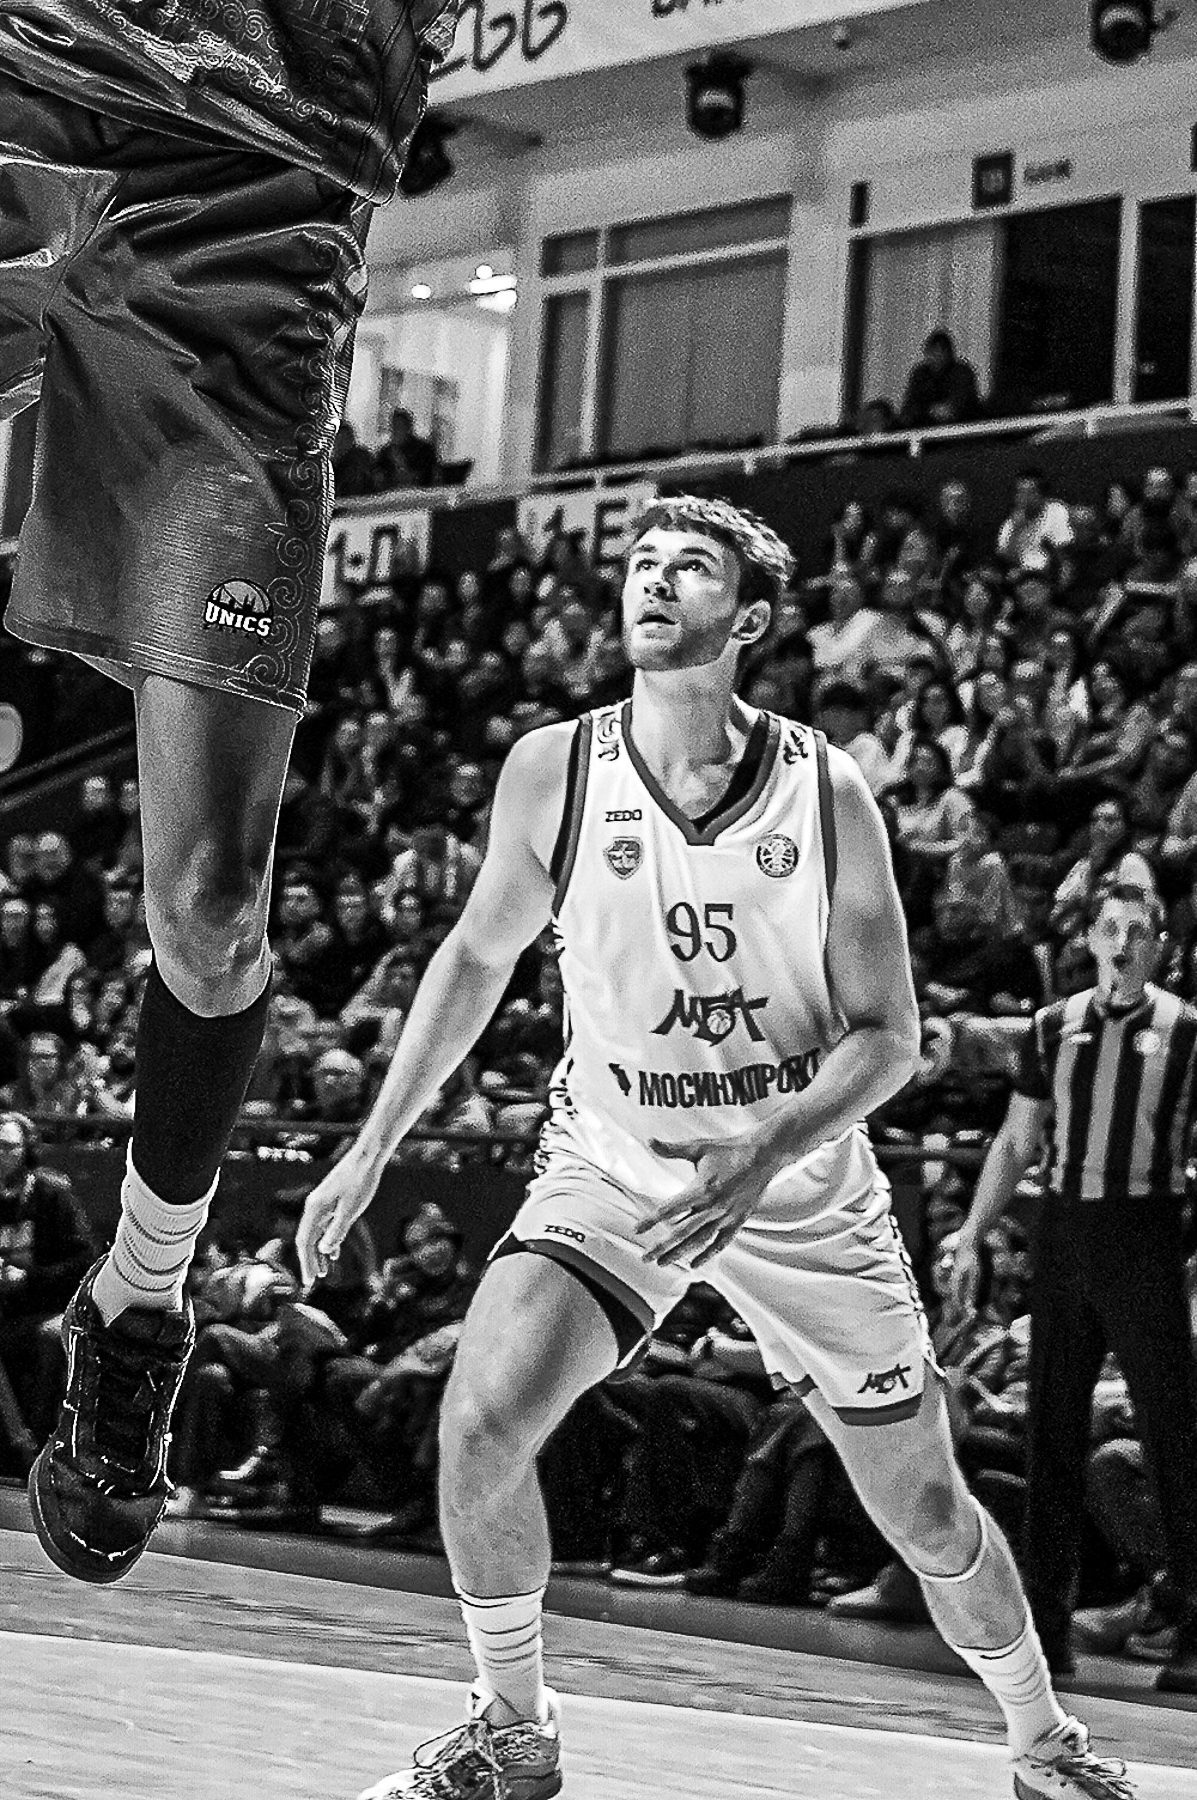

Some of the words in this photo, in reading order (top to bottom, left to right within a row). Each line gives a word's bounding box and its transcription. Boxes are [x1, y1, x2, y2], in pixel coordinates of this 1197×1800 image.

[205, 601, 272, 637] UNICS
[605, 808, 642, 823] ZEDO
[666, 901, 737, 964] 95
